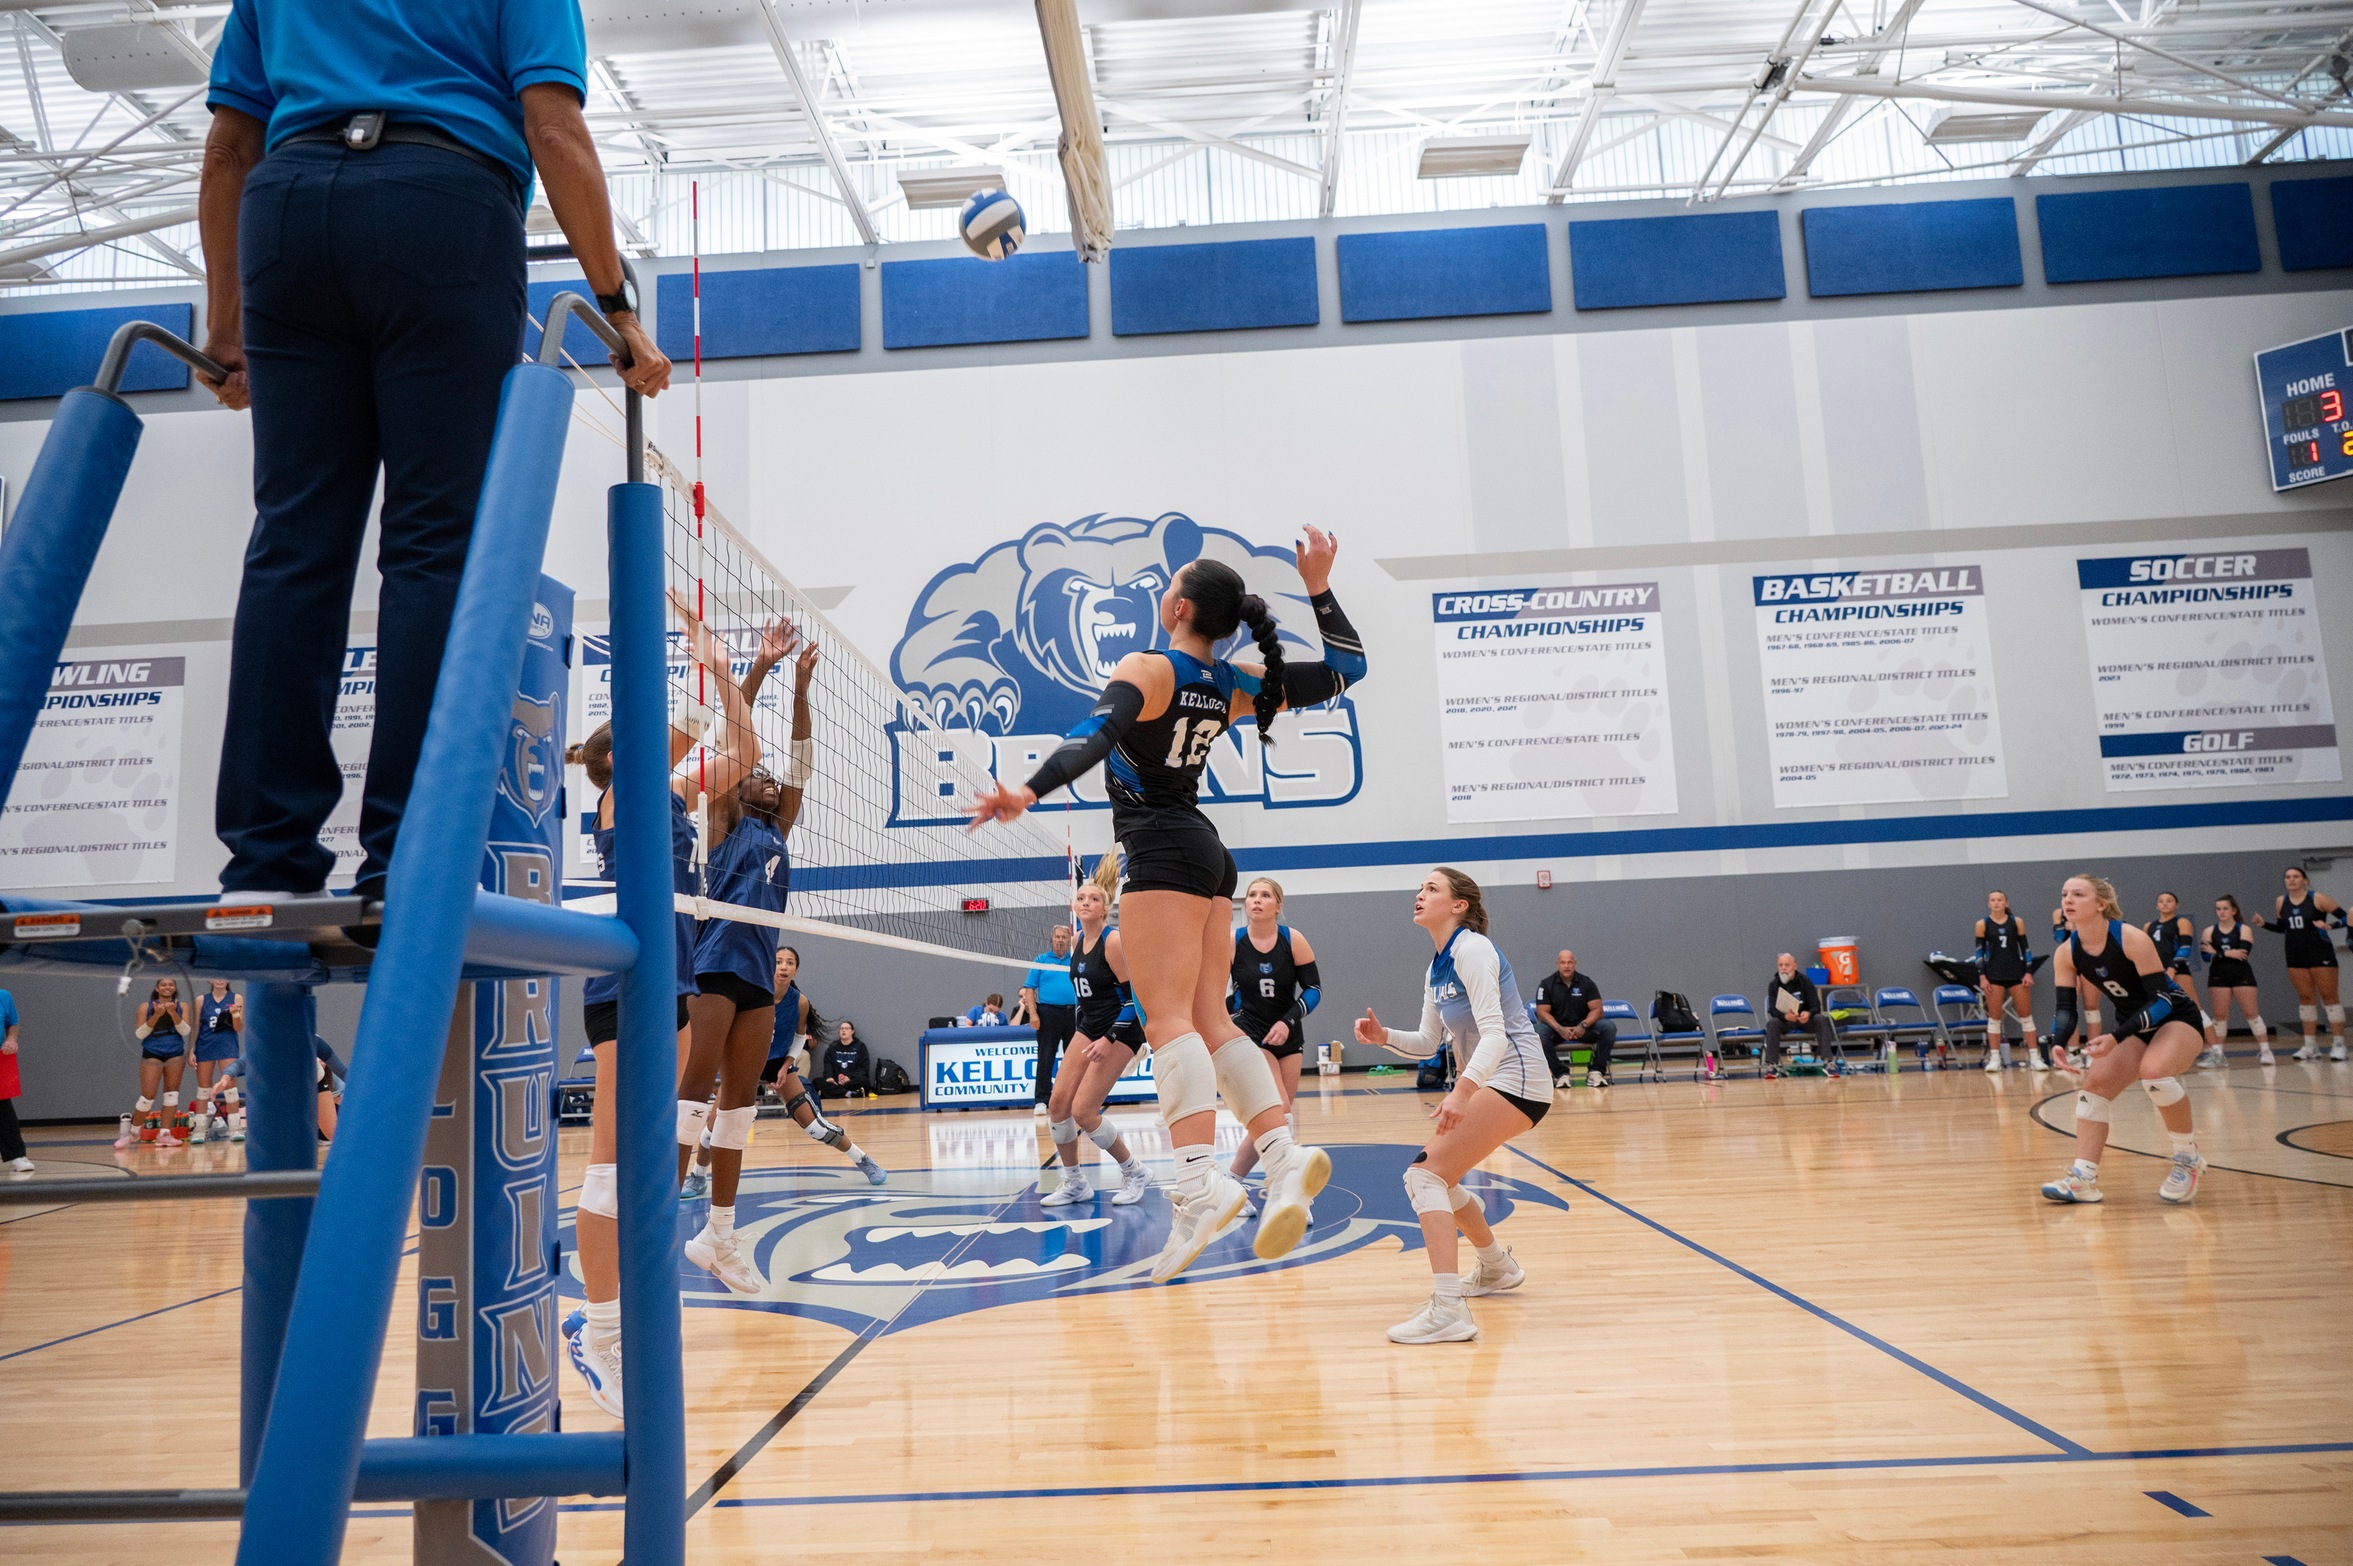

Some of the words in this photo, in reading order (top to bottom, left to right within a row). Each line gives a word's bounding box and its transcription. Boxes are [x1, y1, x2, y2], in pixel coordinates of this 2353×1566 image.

[2286, 373, 2335, 397] HOME
[2320, 390, 2343, 422] 3
[2283, 428, 2319, 445] FOULS
[2310, 442, 2319, 462] 1
[2288, 466, 2325, 483] SCORE
[2129, 555, 2256, 582] SOCCER
[1760, 570, 1977, 601] BASKETBALL
[1437, 587, 1653, 615] CROSS-COUNTRY
[2102, 584, 2293, 607] CHAMPIONSHIPS
[1775, 601, 1964, 624] CHAMPIONSHIPS
[2091, 614, 2148, 626] WOMEN'S
[2151, 610, 2265, 624] CONFERENCE/STATE
[2268, 608, 2306, 617] TITLES
[1457, 617, 1645, 640] CHAMPIONSHIPS
[1766, 632, 1803, 642] MEN'S
[1806, 628, 1918, 641] CONFERENCE/STATE
[1921, 626, 1958, 635] TITLES
[1442, 648, 1498, 659] WOMEN'S
[1500, 643, 1612, 657] CONFERENCE/STATE
[1616, 641, 1652, 651] TITLES
[2098, 663, 2154, 673] WOMEN'S
[2157, 657, 2274, 671] REGIONAL/DISTRICT
[2277, 655, 2315, 664] TITLES
[51, 662, 151, 686] WLING
[1770, 677, 1809, 687] MEN'S
[1812, 670, 1933, 684] REGIONAL/DISTRICT
[1937, 668, 1976, 678] TITLES
[41, 691, 162, 709] PIONSHIPS
[1446, 696, 1501, 706] WOMEN'S
[1504, 690, 1617, 703] REGIONAL/DISTRICT
[1621, 688, 1658, 697] TITLES
[1775, 720, 1831, 730] WOMEN'S
[1834, 714, 1948, 727] CONFERENCE/STATE
[1951, 712, 1988, 721] TITLES
[2103, 711, 2142, 721] MEN'S
[2146, 705, 2266, 719] CONFERENCE/STATE
[2270, 703, 2311, 713] TITLES
[34, 718, 116, 728] FERENCE/STATE
[119, 716, 154, 724] TITLES
[1448, 739, 1485, 750] MEN'S
[1487, 734, 1600, 748] CONFERENCE/STATE
[1603, 732, 1640, 742] TITLES
[2183, 732, 2255, 752] GOLF
[18, 759, 115, 770] EGIONAL/DISTRICT
[118, 757, 153, 766] TITLES
[886, 708, 1361, 827] BRNS
[1779, 764, 1836, 774] WOMEN'S
[1839, 757, 1955, 771] REGIONAL/DISTRICT
[1958, 755, 1996, 765] TITLES
[2110, 762, 2145, 771] MEN'S
[2147, 758, 2254, 770] CONFERENCE/STATE
[2257, 756, 2293, 764] TITLES
[1451, 782, 1488, 793] MEN'S
[1490, 778, 1605, 792] REGIONAL/DISTRICT
[1608, 776, 1646, 786] TITLES
[24, 800, 129, 812] CONFERENCE/STATE
[132, 799, 168, 807] TITLES
[21, 843, 129, 855] REGIONAL/DISTRICT
[131, 841, 167, 849] TITLES
[2289, 916, 2304, 929] 10
[1999, 935, 2008, 948] 7
[2152, 929, 2161, 942] 4
[1838, 953, 1851, 964] G
[1073, 977, 1093, 997] 16
[1259, 977, 1276, 998] 6
[2102, 980, 2128, 998] 8
[975, 1046, 1038, 1056] WELCOME
[936, 1059, 1038, 1083] KELLO
[935, 1083, 1029, 1096] COMMUNITY
